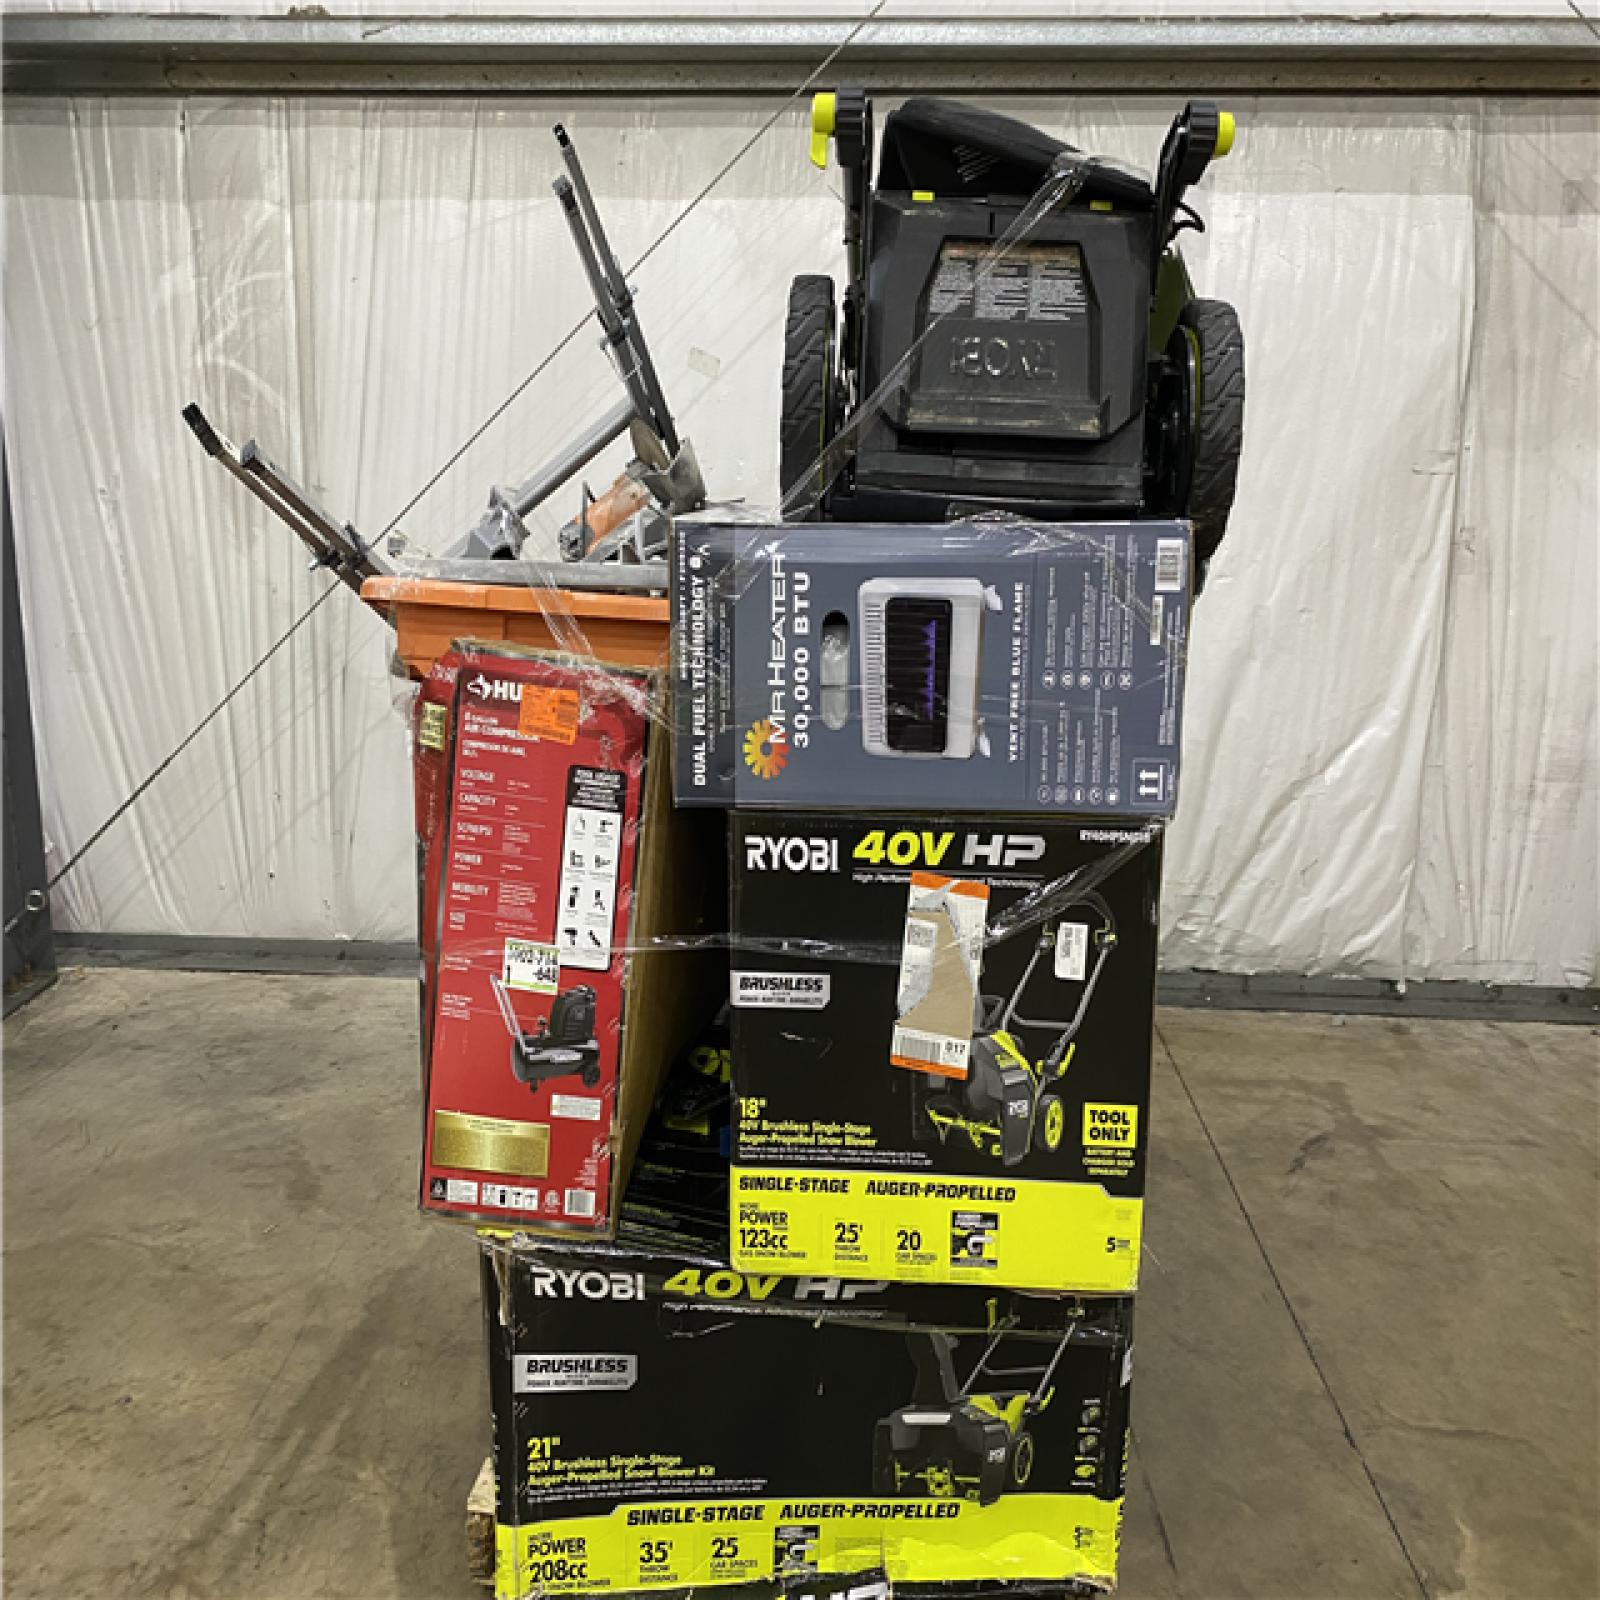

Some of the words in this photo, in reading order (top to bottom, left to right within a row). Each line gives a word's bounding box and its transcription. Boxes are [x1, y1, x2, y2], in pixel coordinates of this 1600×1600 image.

[793, 571, 811, 635] BTU
[1012, 582, 1023, 631] FLAME
[767, 553, 785, 685] HEATER
[691, 575, 706, 690] TECHNOLOGY
[1012, 637, 1021, 676] BLUE
[793, 647, 812, 748] 30,000
[692, 694, 706, 736] FUEL
[692, 741, 706, 786] DUAL
[745, 837, 838, 871] RYOBI
[853, 831, 953, 865] 40V
[962, 834, 1046, 867] HP
[739, 977, 823, 993] BRUSHLESS
[739, 1097, 767, 1119] 18"
[1090, 1109, 1130, 1125] TOOL
[1090, 1127, 1130, 1142] ONLY
[739, 1177, 851, 1195] SINGLE-STAGE
[865, 1179, 1016, 1203] AUGER-PROPELLED
[739, 1211, 788, 1226] POWER
[739, 1229, 788, 1249] 123cc
[834, 1222, 864, 1244] 25'
[896, 1229, 922, 1251] 20
[1107, 1237, 1117, 1253] 5
[531, 1268, 645, 1300] RYOBI
[662, 1269, 782, 1300] 40V
[527, 1359, 628, 1374] BRUSHLESS
[528, 1436, 560, 1459] 21"
[627, 1505, 765, 1526] SINGLE-STAGE
[780, 1503, 960, 1519] AUGER-PROPELLED
[528, 1537, 586, 1558] POWER
[639, 1540, 673, 1564] 35'
[711, 1536, 739, 1559] 25
[529, 1559, 588, 1583] 208cc
